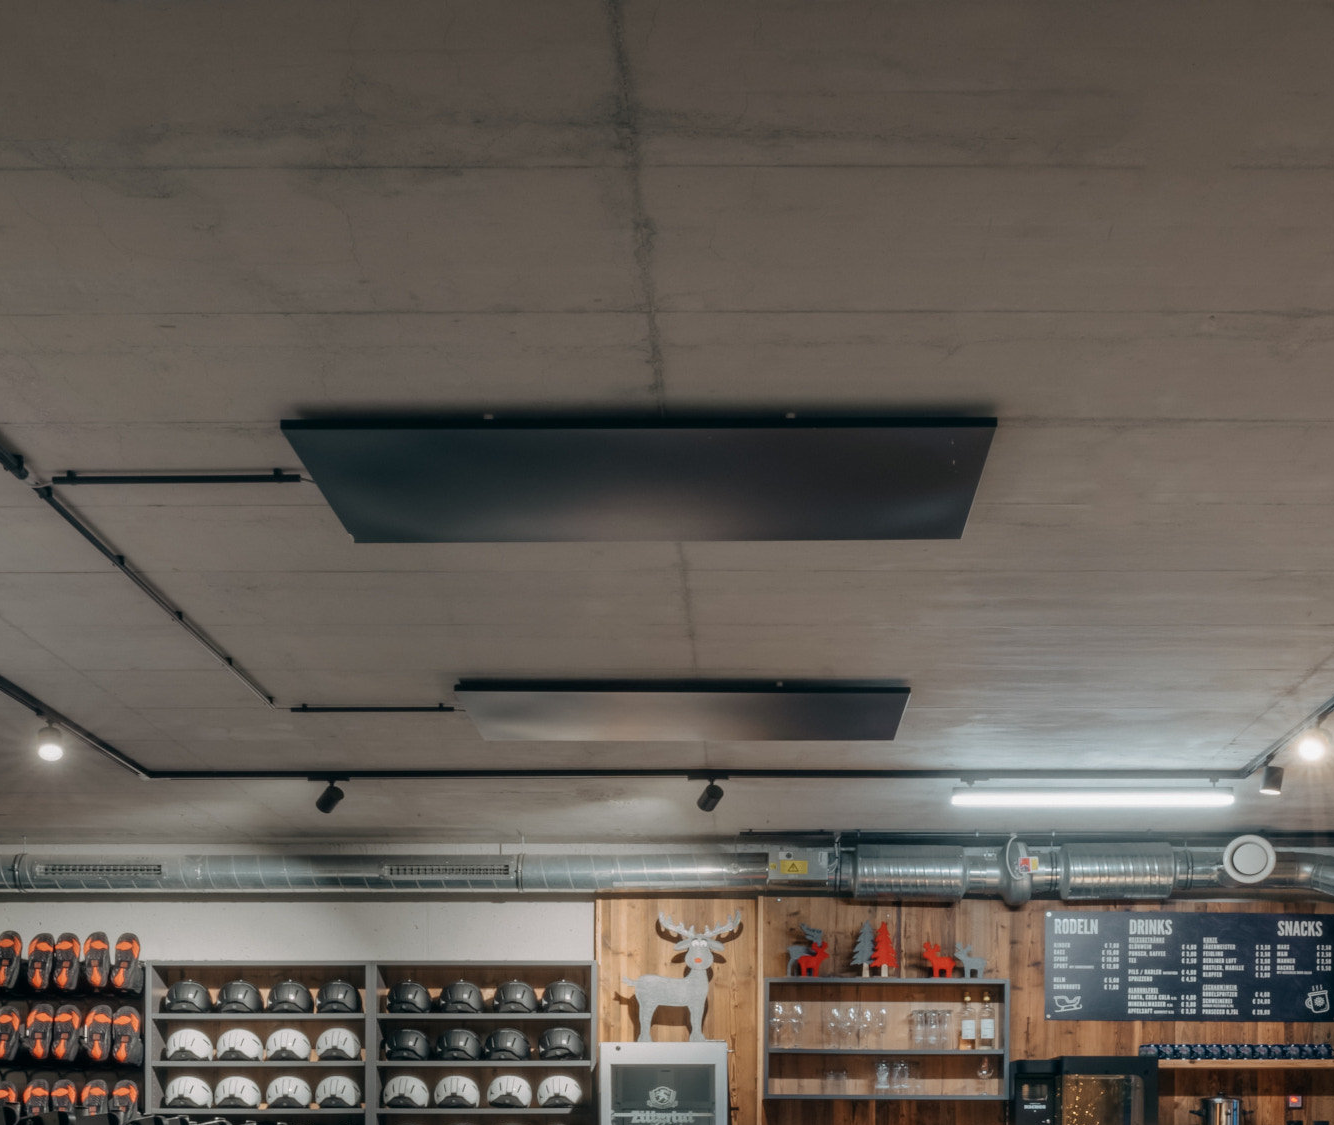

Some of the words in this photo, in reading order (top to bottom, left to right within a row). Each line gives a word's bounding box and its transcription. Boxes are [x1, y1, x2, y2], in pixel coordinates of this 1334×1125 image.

[1054, 918, 1098, 934] RODELN
[1129, 919, 1172, 935] DRINKS
[1277, 920, 1323, 937] SNACKS
